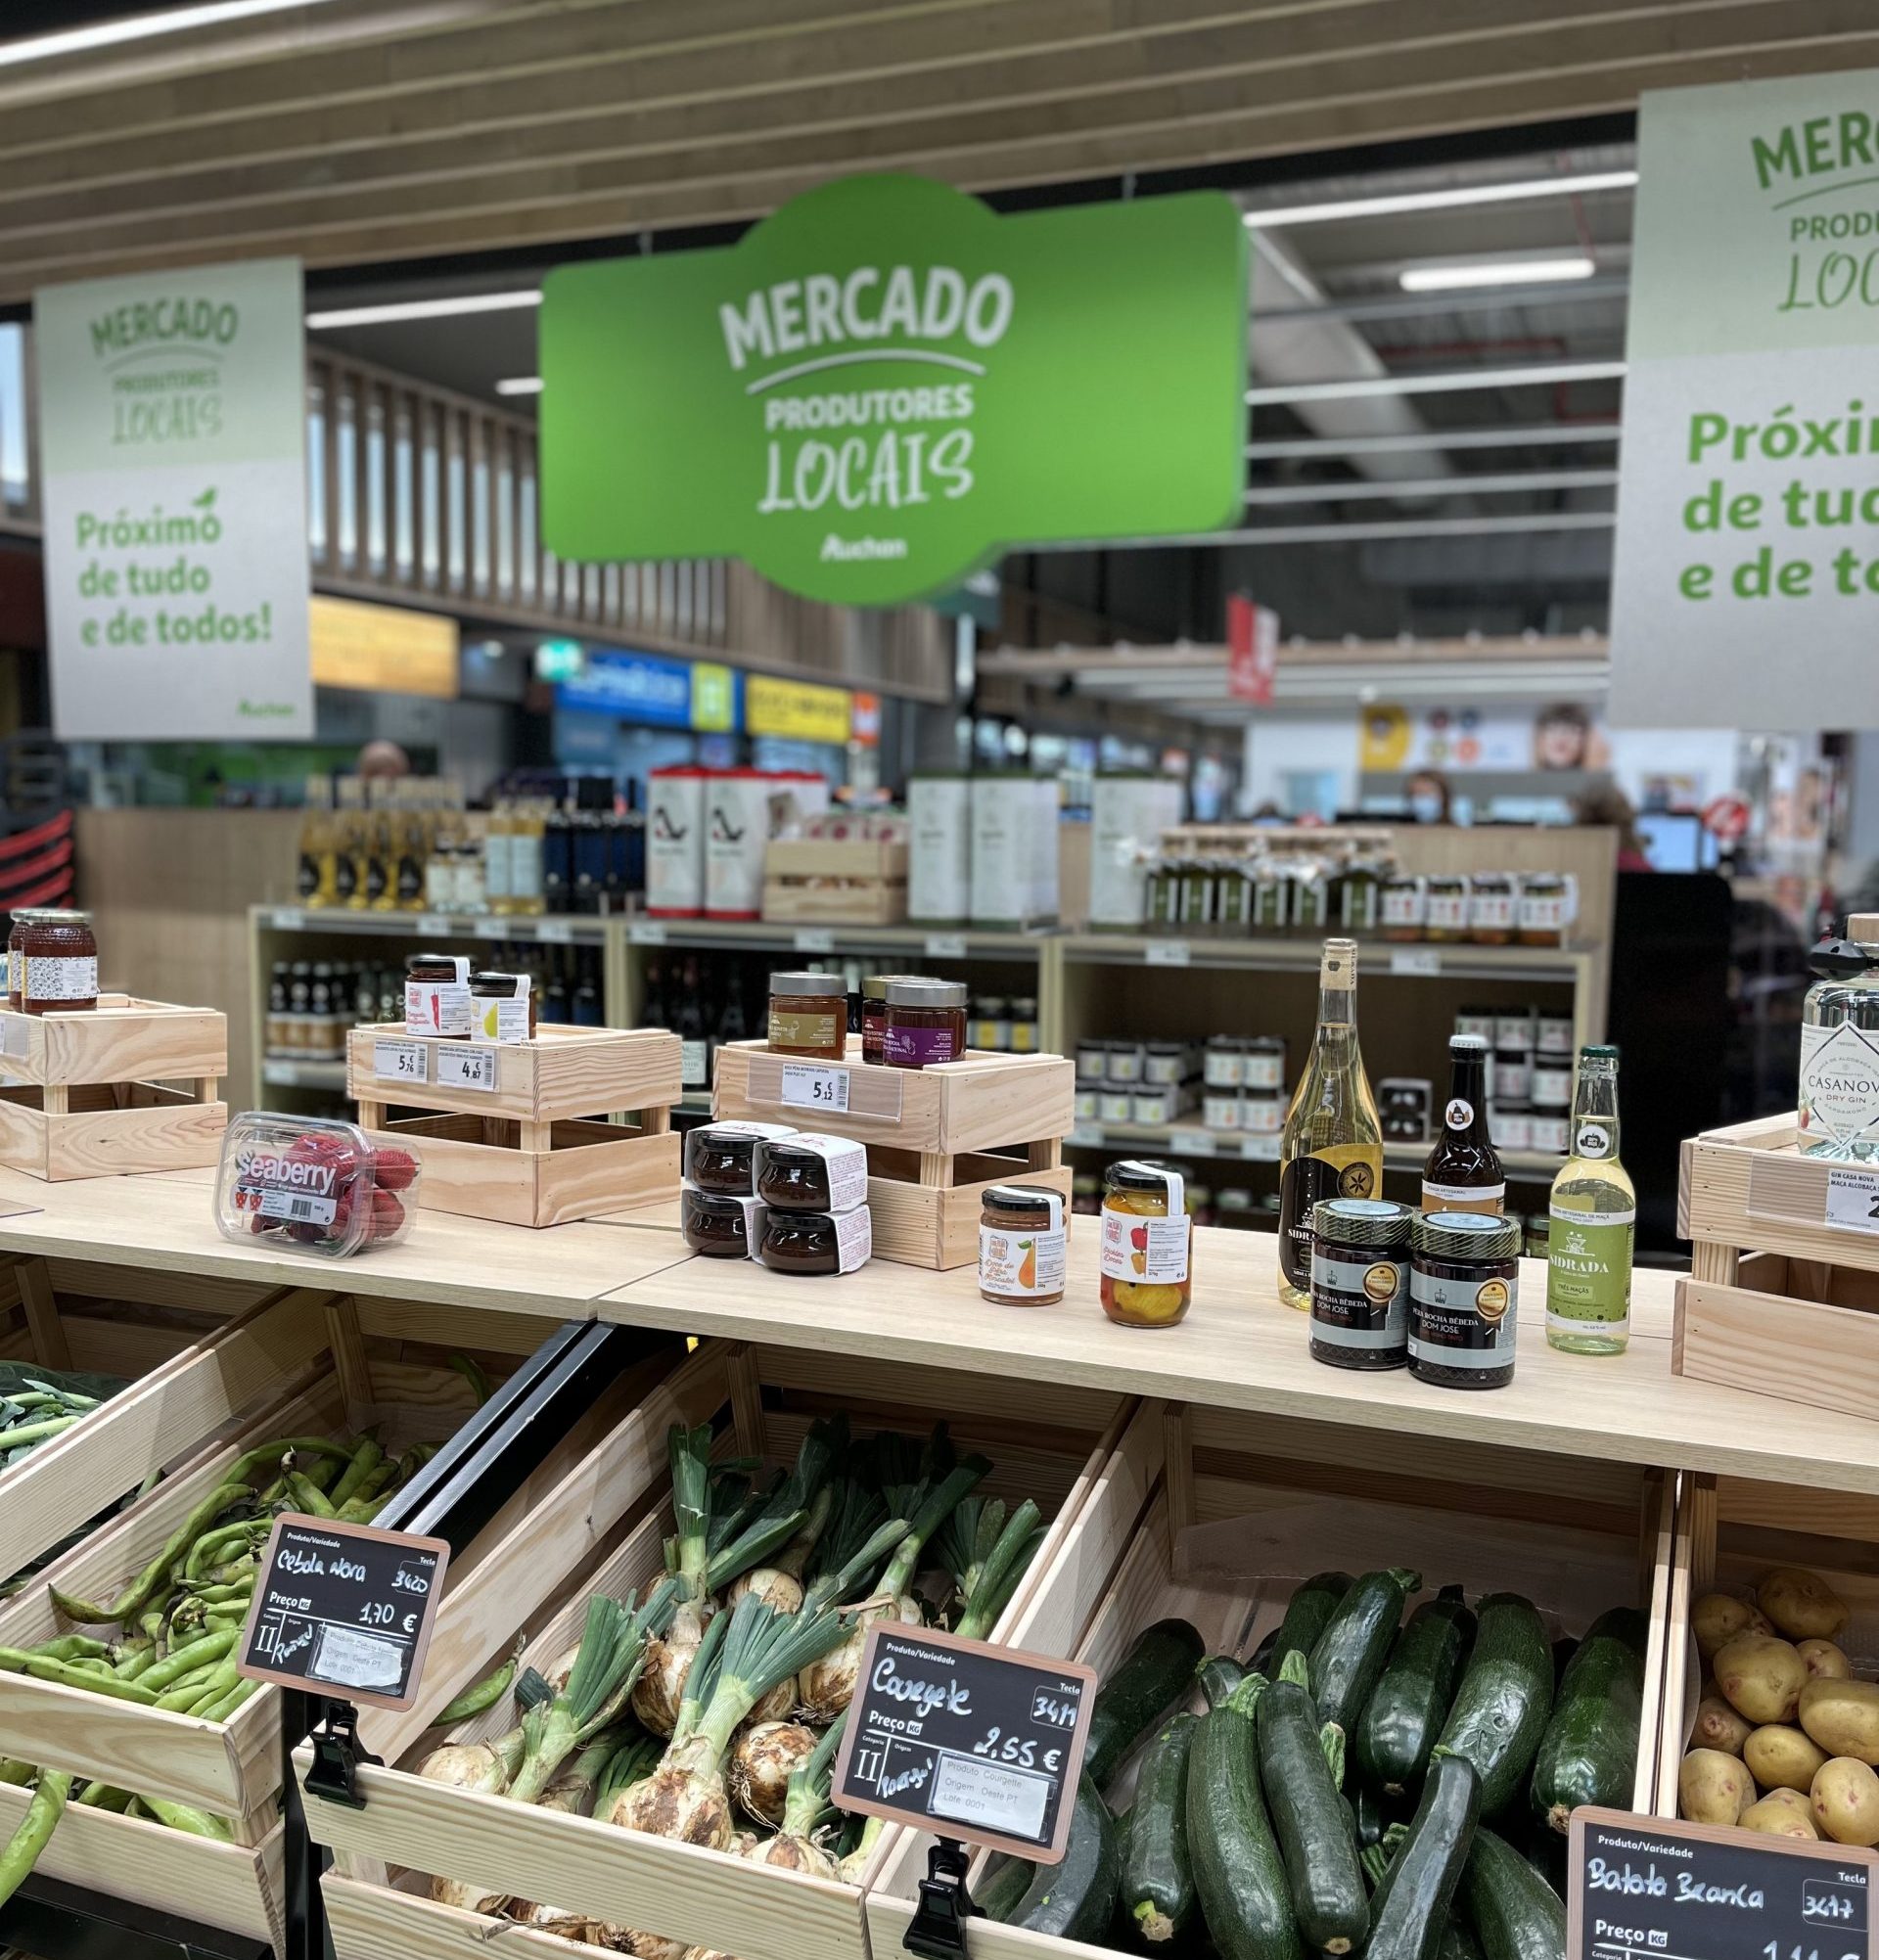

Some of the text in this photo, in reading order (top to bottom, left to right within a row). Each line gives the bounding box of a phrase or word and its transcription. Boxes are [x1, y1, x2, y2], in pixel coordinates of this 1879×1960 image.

[1751, 111, 1879, 190] MER
[1790, 211, 1879, 243] PROD
[90, 298, 239, 357] MERCADO
[720, 266, 1013, 370] MERCADO
[112, 392, 223, 444] LOCAIS
[765, 384, 975, 431] PRODUTORES
[1688, 398, 1879, 465] Próxi
[757, 428, 976, 512] LOCAIS
[1683, 479, 1763, 533] de
[75, 503, 221, 549] Próximo
[819, 533, 907, 564] Auchan
[78, 557, 210, 598] de tudo
[1678, 563, 1715, 601] e
[1731, 544, 1813, 600] de
[80, 603, 272, 646] e de todos!
[1848, 1182, 1877, 1192] ALCOBAÇA
[1288, 1228, 1316, 1242] SIDRA
[1316, 1299, 1331, 1310] DOM
[1319, 1293, 1338, 1304] ROCHA
[1421, 1319, 1439, 1331] DOM
[1424, 1311, 1447, 1324] ROCHA
[287, 1531, 341, 1549] Produto/Variedade
[420, 1557, 435, 1566] Tecla
[269, 1591, 298, 1610] Preço
[358, 1601, 418, 1633] 1,70 €
[886, 1642, 956, 1666] Produto/Variedade
[1060, 1682, 1080, 1695] Tecla
[869, 1709, 922, 1735] Preço KG
[862, 1735, 912, 1753] Categoria Origem
[1042, 1749, 1062, 1772] €
[944, 1777, 1019, 1804] Origem Oeste PT
[1598, 1835, 1694, 1859] Produto/Variedade
[1587, 1857, 1668, 1896] Batata
[1838, 1871, 1866, 1885] Tecla
[1595, 1919, 1667, 1946] Preço KG
